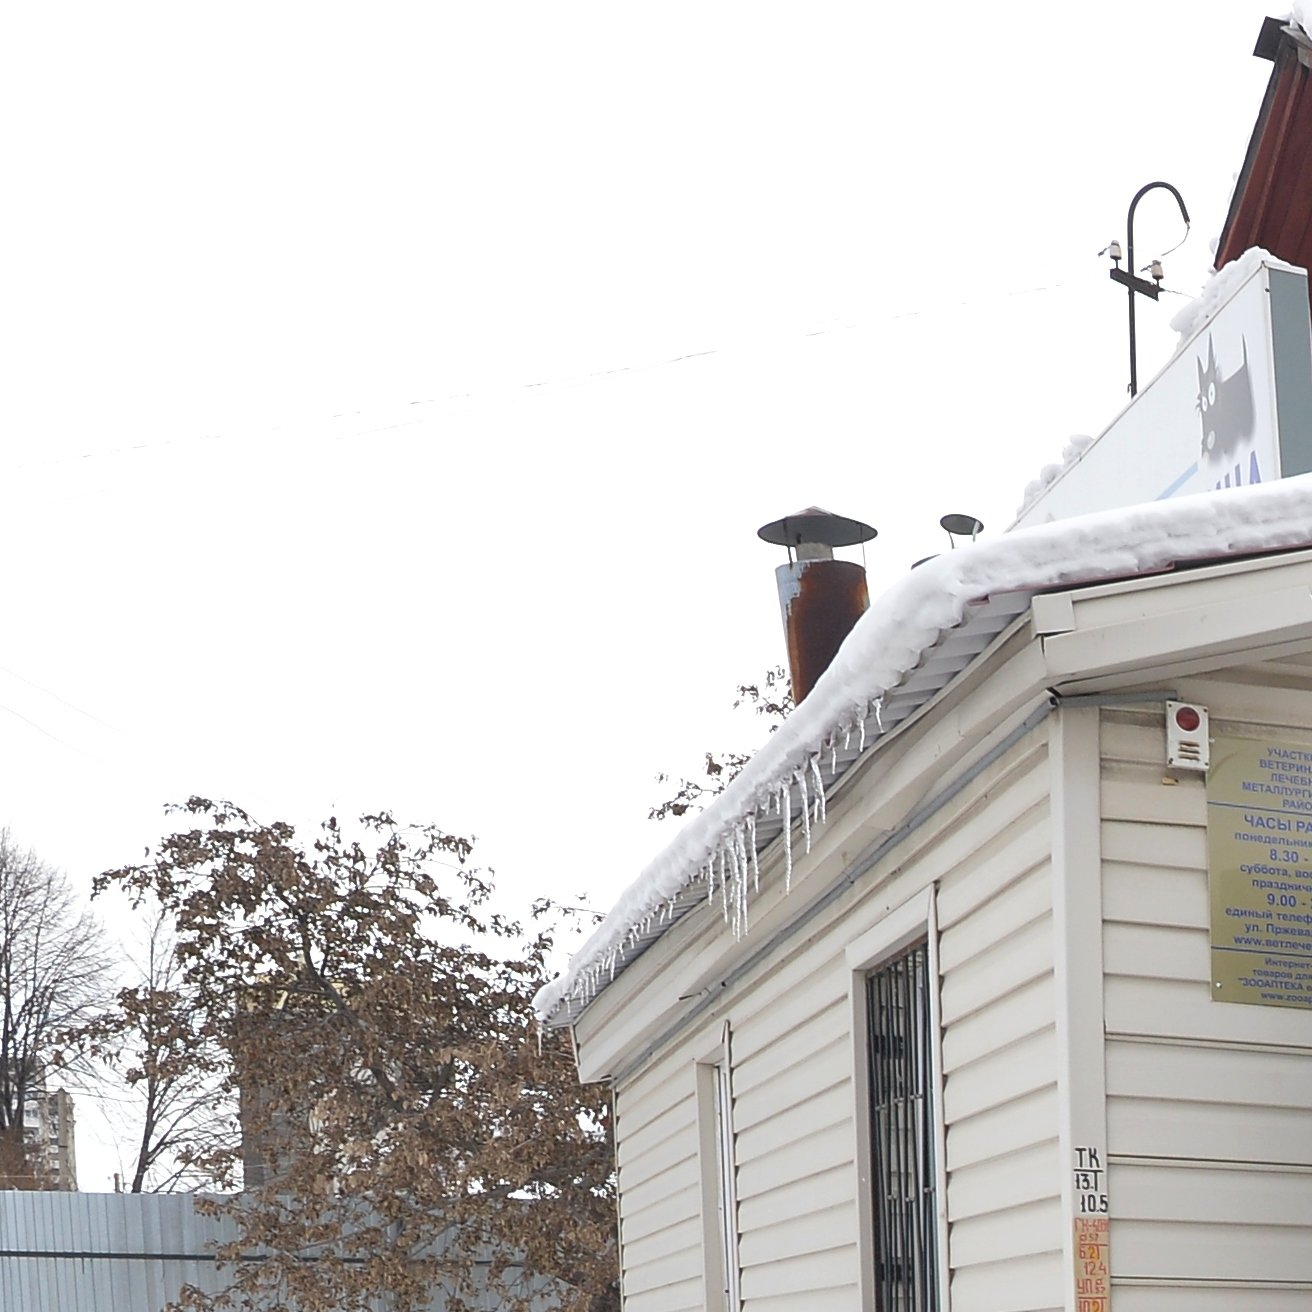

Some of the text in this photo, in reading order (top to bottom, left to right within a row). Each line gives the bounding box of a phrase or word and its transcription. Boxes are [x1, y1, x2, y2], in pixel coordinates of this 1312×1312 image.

[1244, 814, 1291, 831] ЧАСЫ
[1234, 832, 1312, 848] понедельник
[1269, 849, 1299, 863] 8.30
[1240, 863, 1291, 878] суббота,
[1267, 893, 1297, 907] 9.00
[1225, 907, 1272, 919] единый
[1245, 923, 1262, 933] ул.
[1253, 968, 1293, 980] товаров
[1295, 972, 1312, 981] для
[1074, 1147, 1100, 1168] ТК
[1080, 1194, 1108, 1212] 10.5
